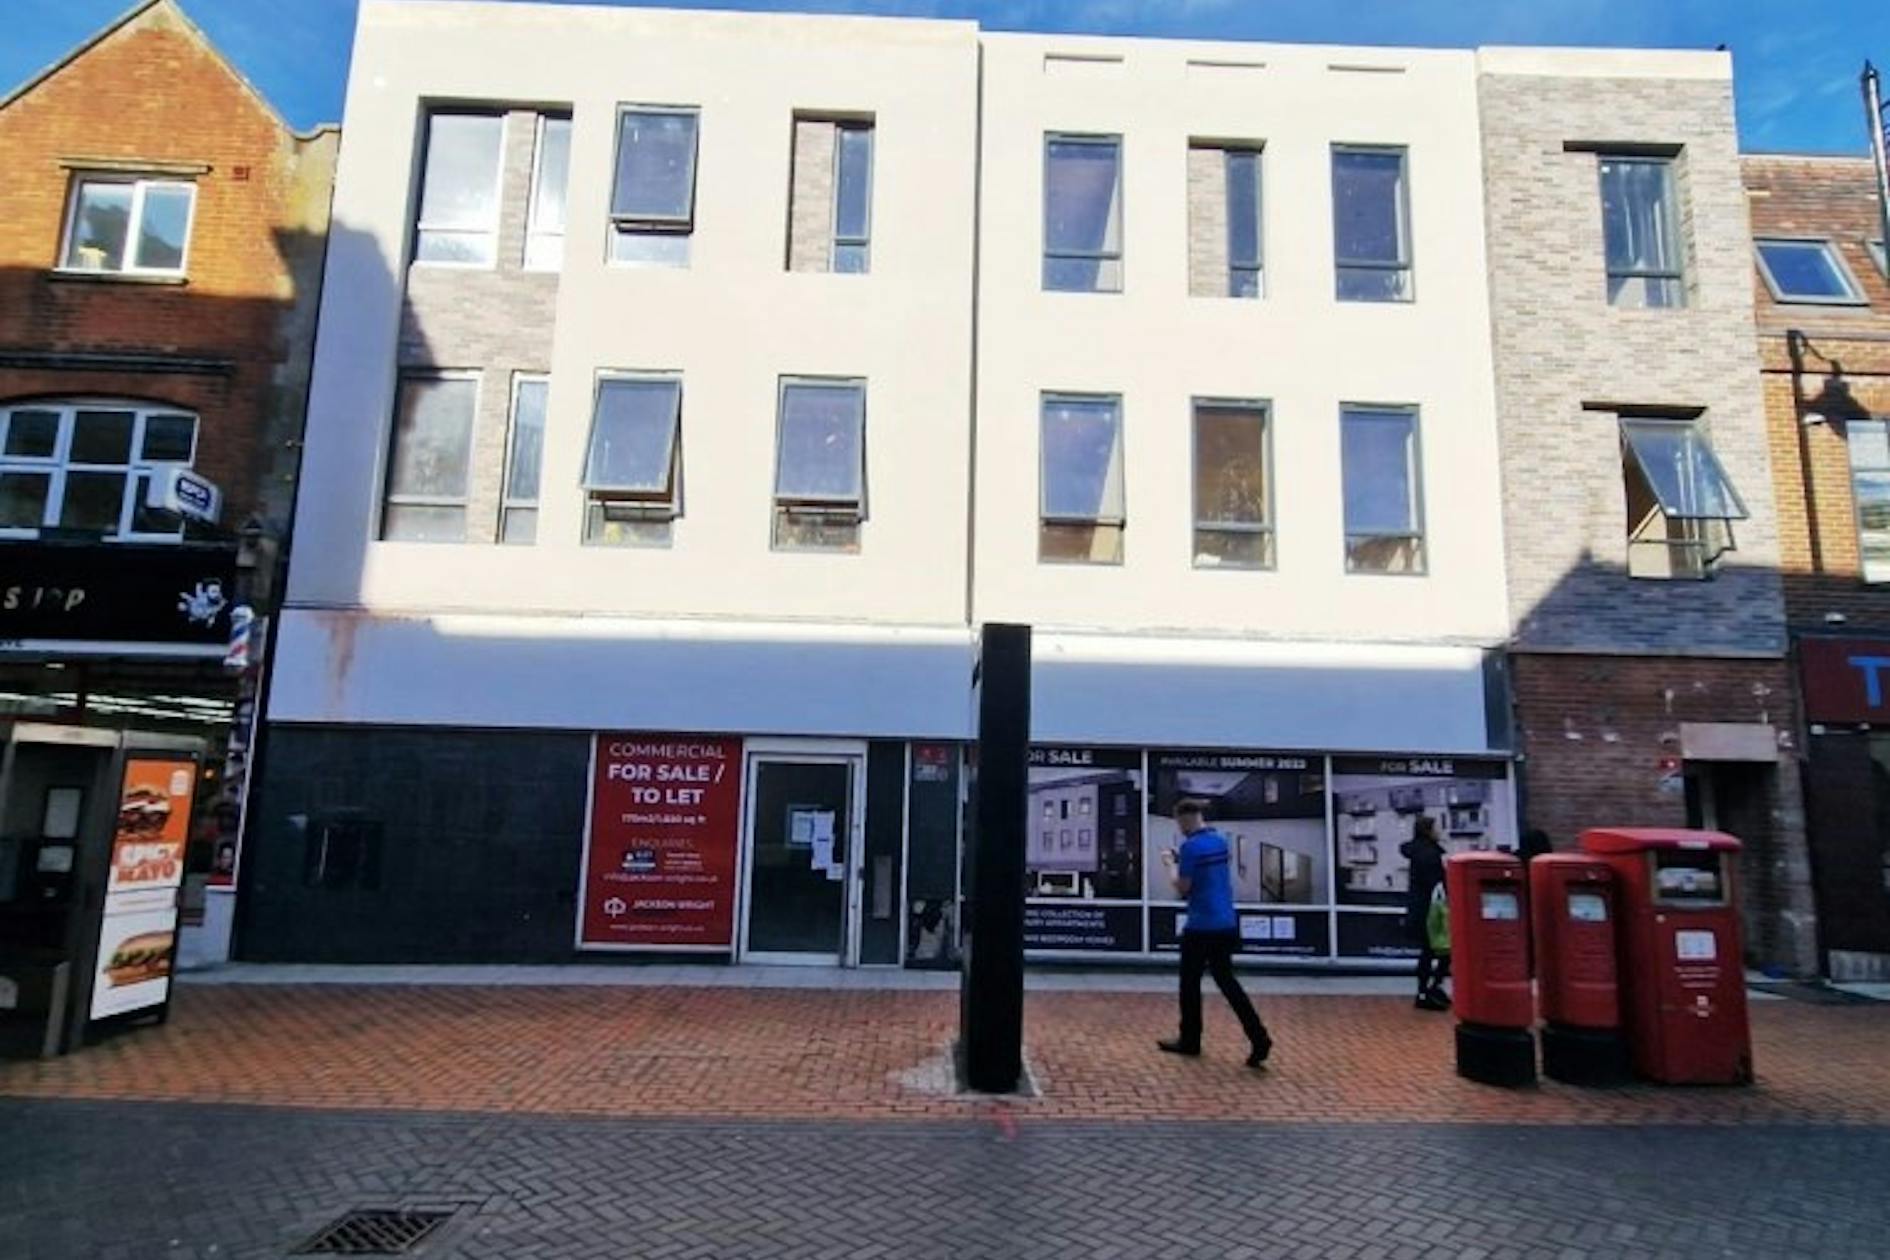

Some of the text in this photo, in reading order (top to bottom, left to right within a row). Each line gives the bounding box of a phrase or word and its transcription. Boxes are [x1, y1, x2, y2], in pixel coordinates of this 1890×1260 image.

[609, 742, 726, 759] COMMERCIAL
[1047, 749, 1093, 765] SALE
[1220, 757, 1276, 769] SUMMER
[1408, 759, 1455, 775] SALE
[608, 763, 725, 784] FOR SALE /
[631, 787, 704, 804] TO LET
[633, 899, 715, 910] JACKSON WRIGHT
